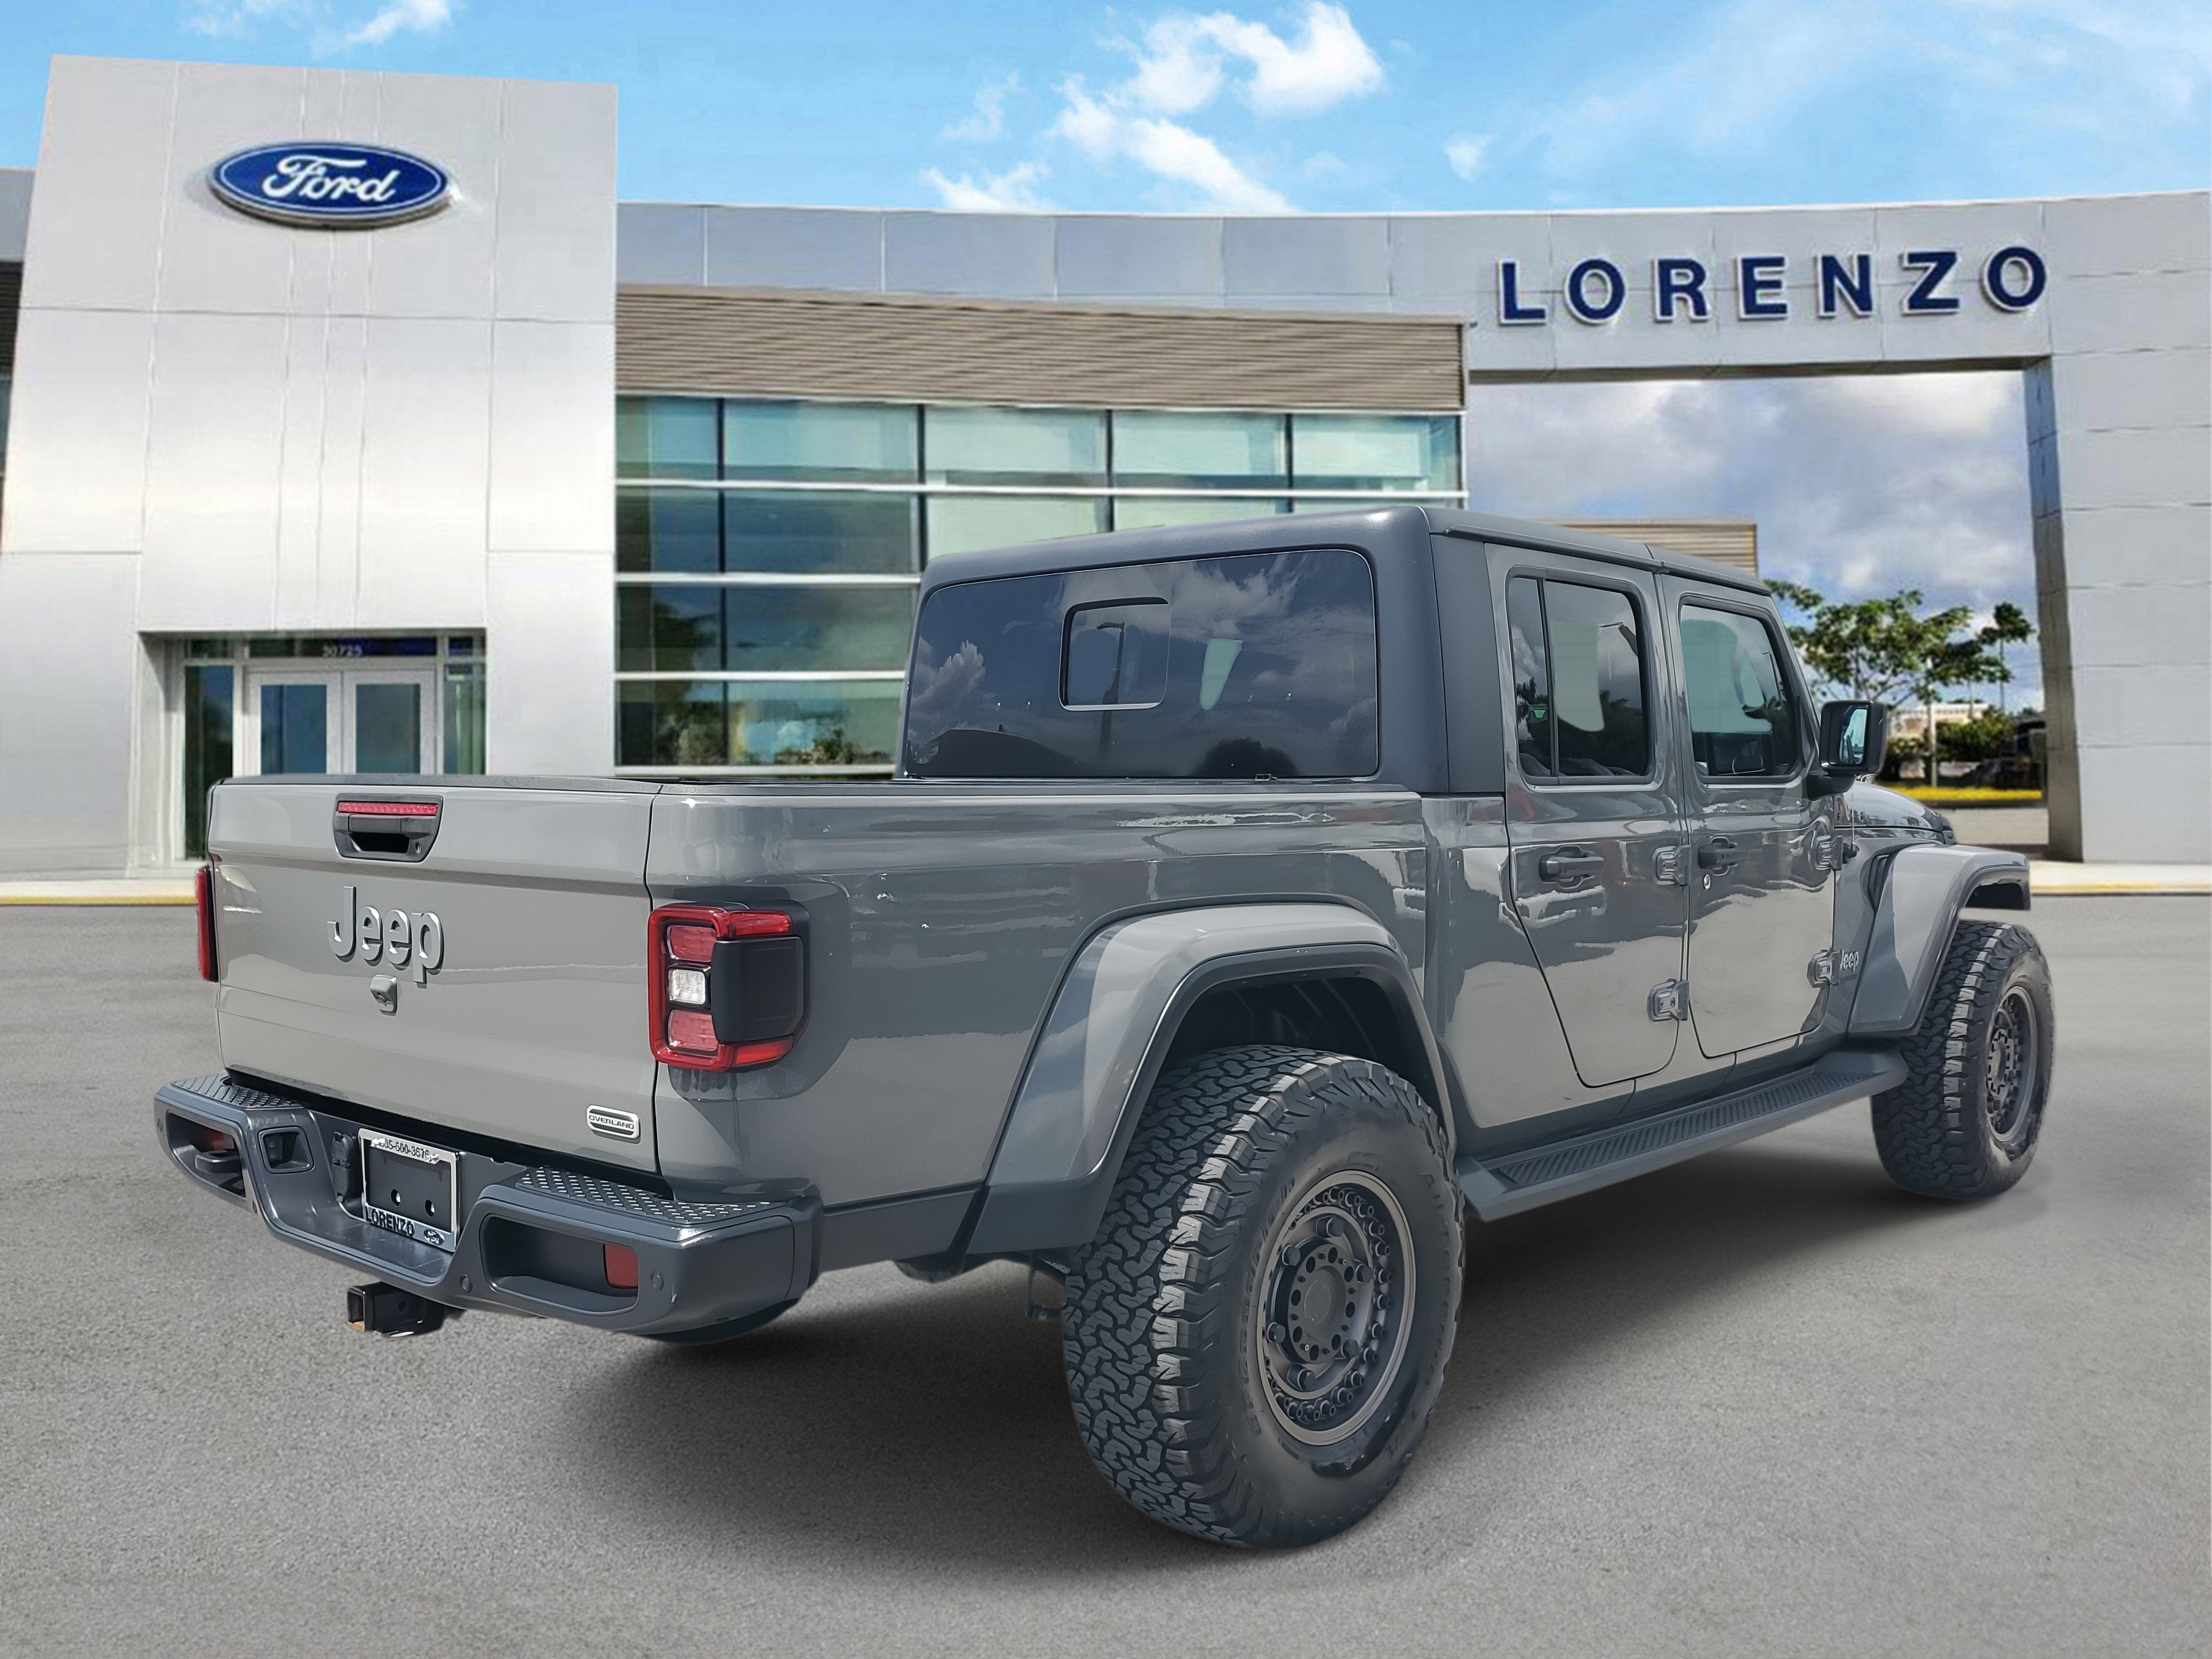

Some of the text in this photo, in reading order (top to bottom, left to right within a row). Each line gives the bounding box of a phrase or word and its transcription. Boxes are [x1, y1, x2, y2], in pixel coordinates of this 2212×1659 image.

[263, 155, 400, 201] Ford
[1498, 246, 2048, 325] LORENZO
[327, 886, 444, 987] Jeep
[1840, 949, 1859, 972] Jeep
[589, 1115, 635, 1129] OVERLAND
[367, 1203, 415, 1238] LORENZO
